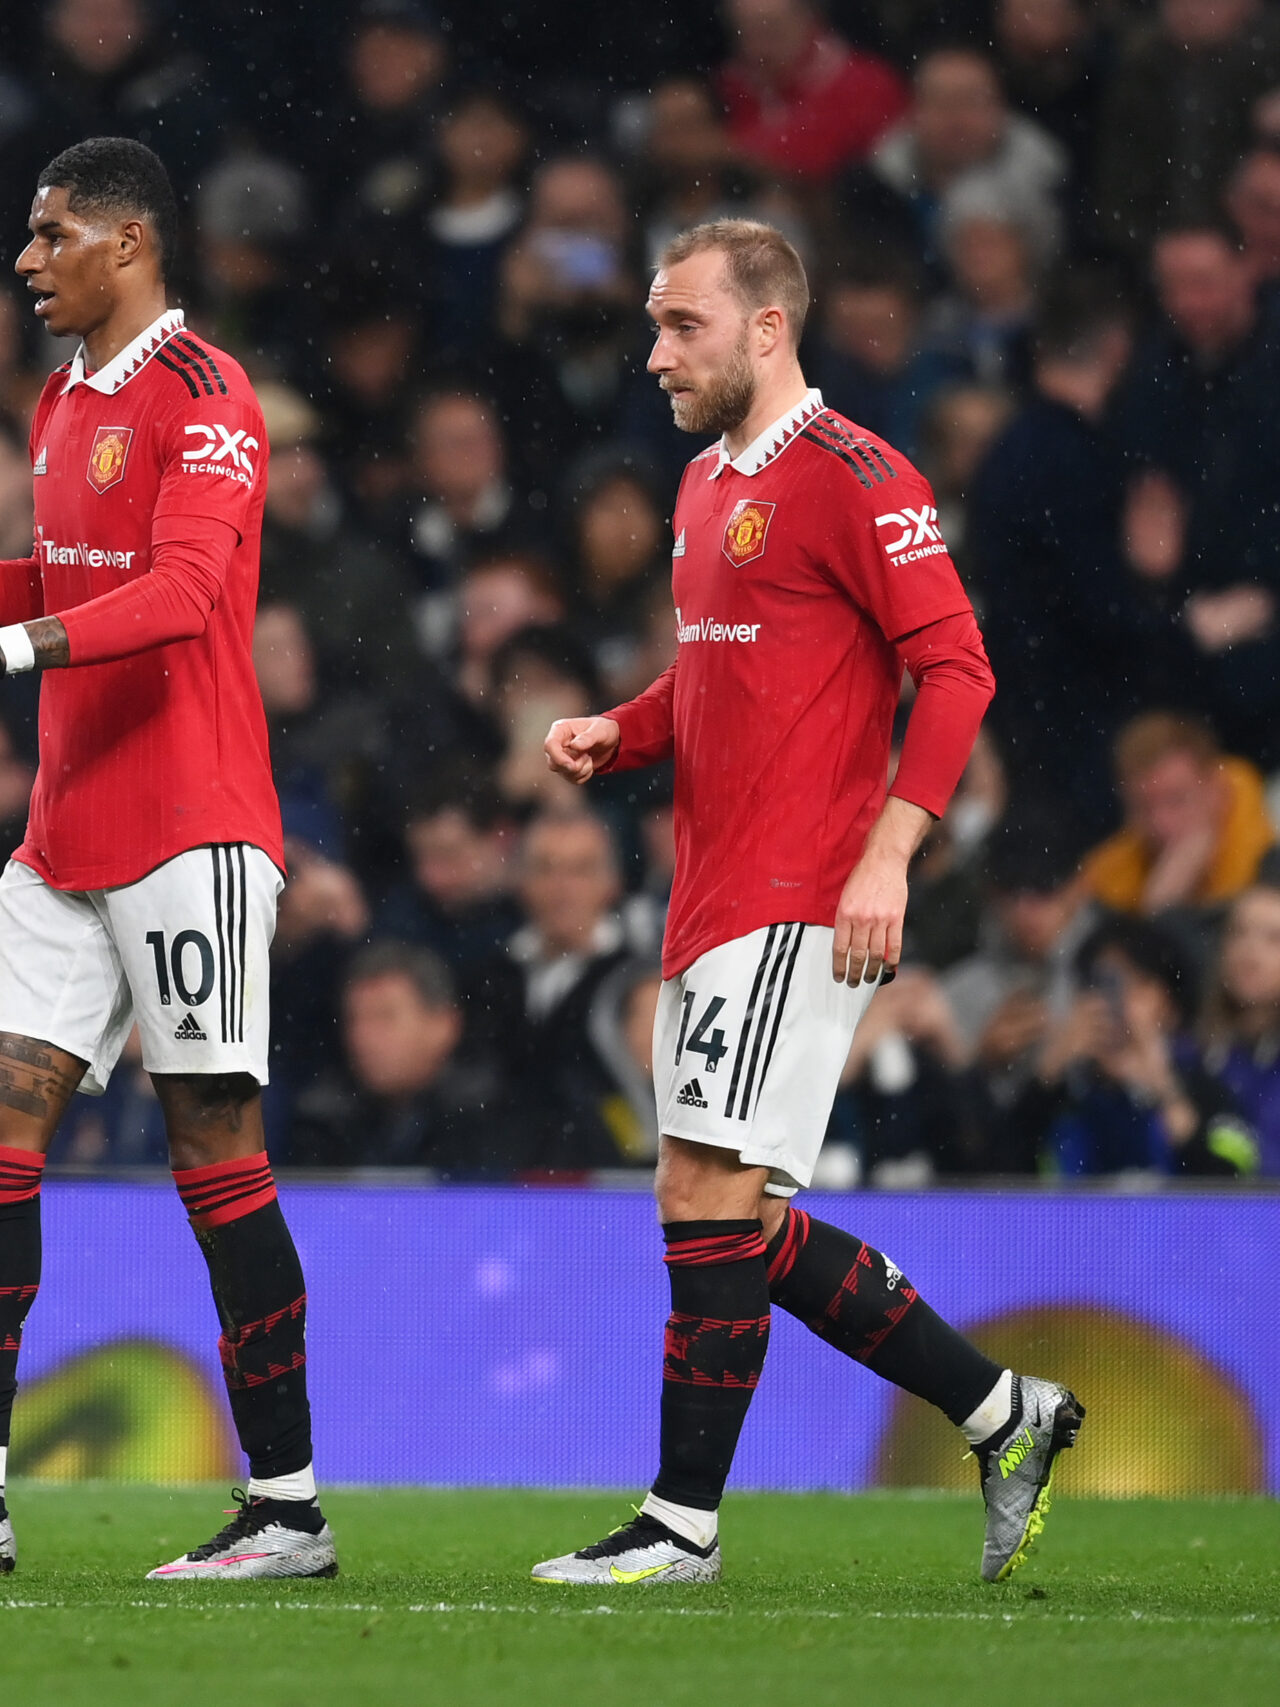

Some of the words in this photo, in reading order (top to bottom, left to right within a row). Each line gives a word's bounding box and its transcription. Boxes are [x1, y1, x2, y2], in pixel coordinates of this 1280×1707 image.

[182, 424, 259, 478] DXC
[42, 540, 136, 569] TeamViewer
[145, 929, 215, 1007] 10
[174, 1030, 207, 1041] adidas
[675, 990, 729, 1073] 14
